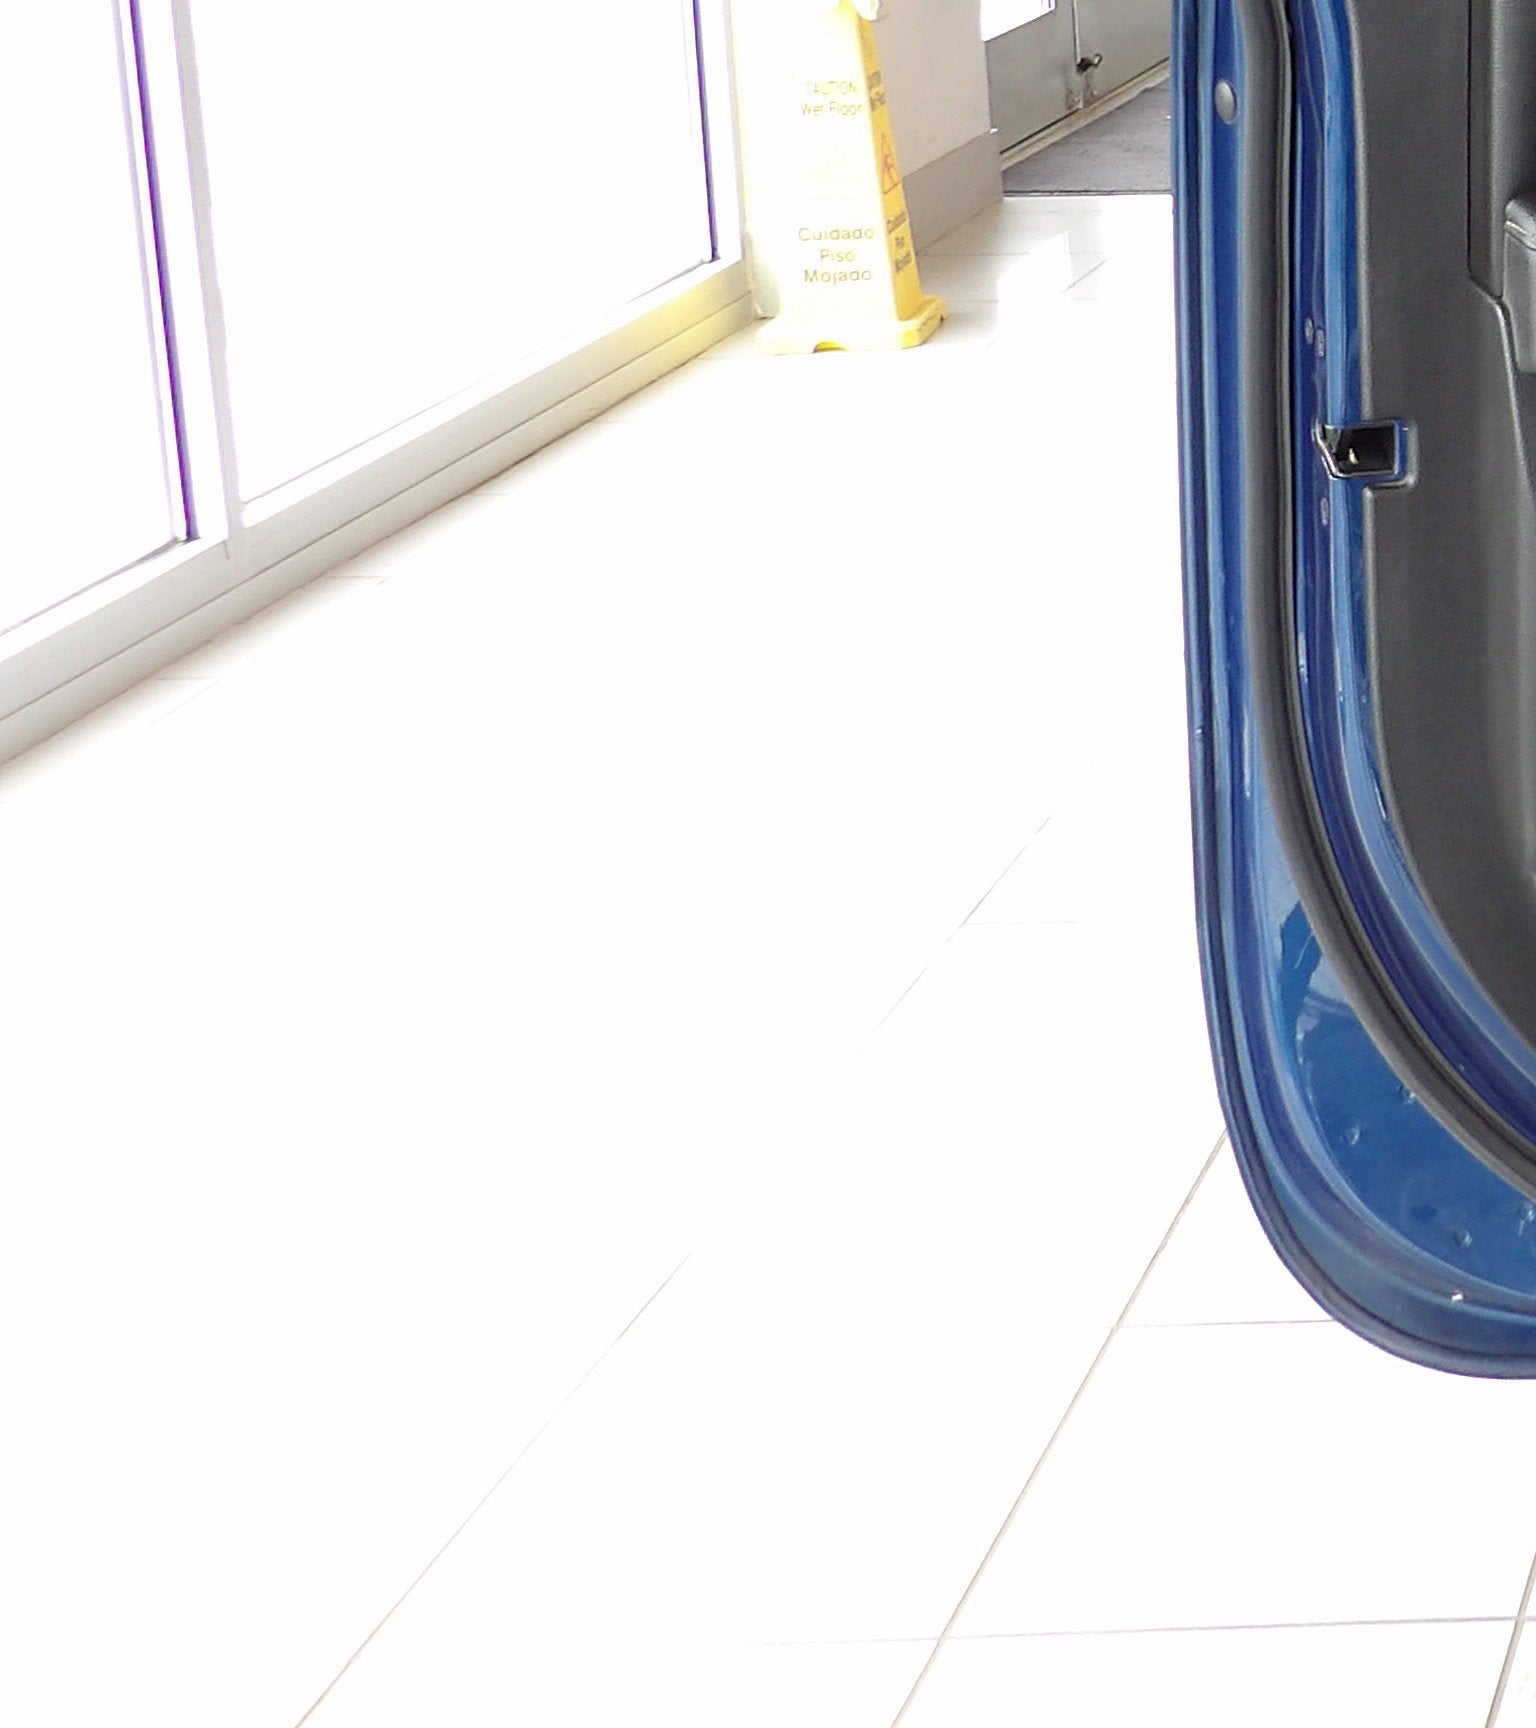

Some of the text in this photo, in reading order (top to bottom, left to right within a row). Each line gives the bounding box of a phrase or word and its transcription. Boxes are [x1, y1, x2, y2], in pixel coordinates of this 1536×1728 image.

[801, 102, 863, 116] Wet Floor
[798, 227, 876, 242] Cuidado
[819, 249, 855, 263] Piso
[803, 269, 874, 285] Mojado
